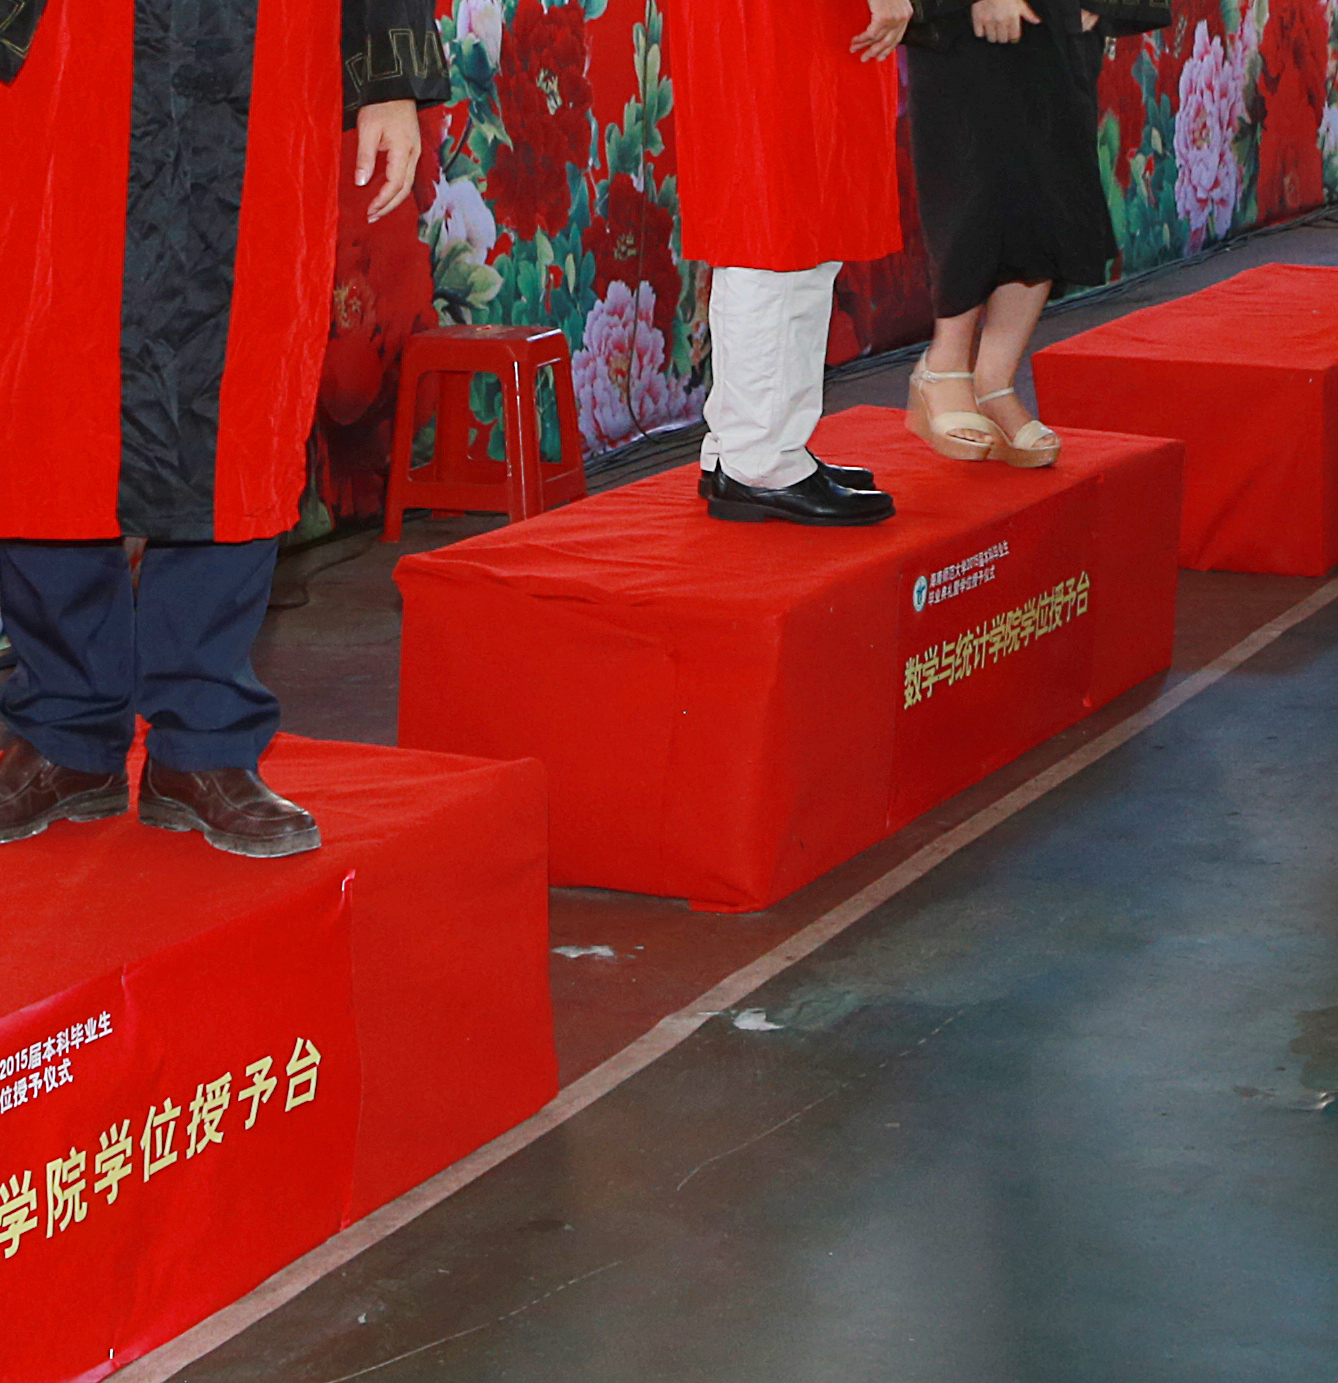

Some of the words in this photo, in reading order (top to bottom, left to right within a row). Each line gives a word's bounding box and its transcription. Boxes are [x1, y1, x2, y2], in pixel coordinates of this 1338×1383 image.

[903, 570, 1091, 710] 数学与统计学院学位授予台
